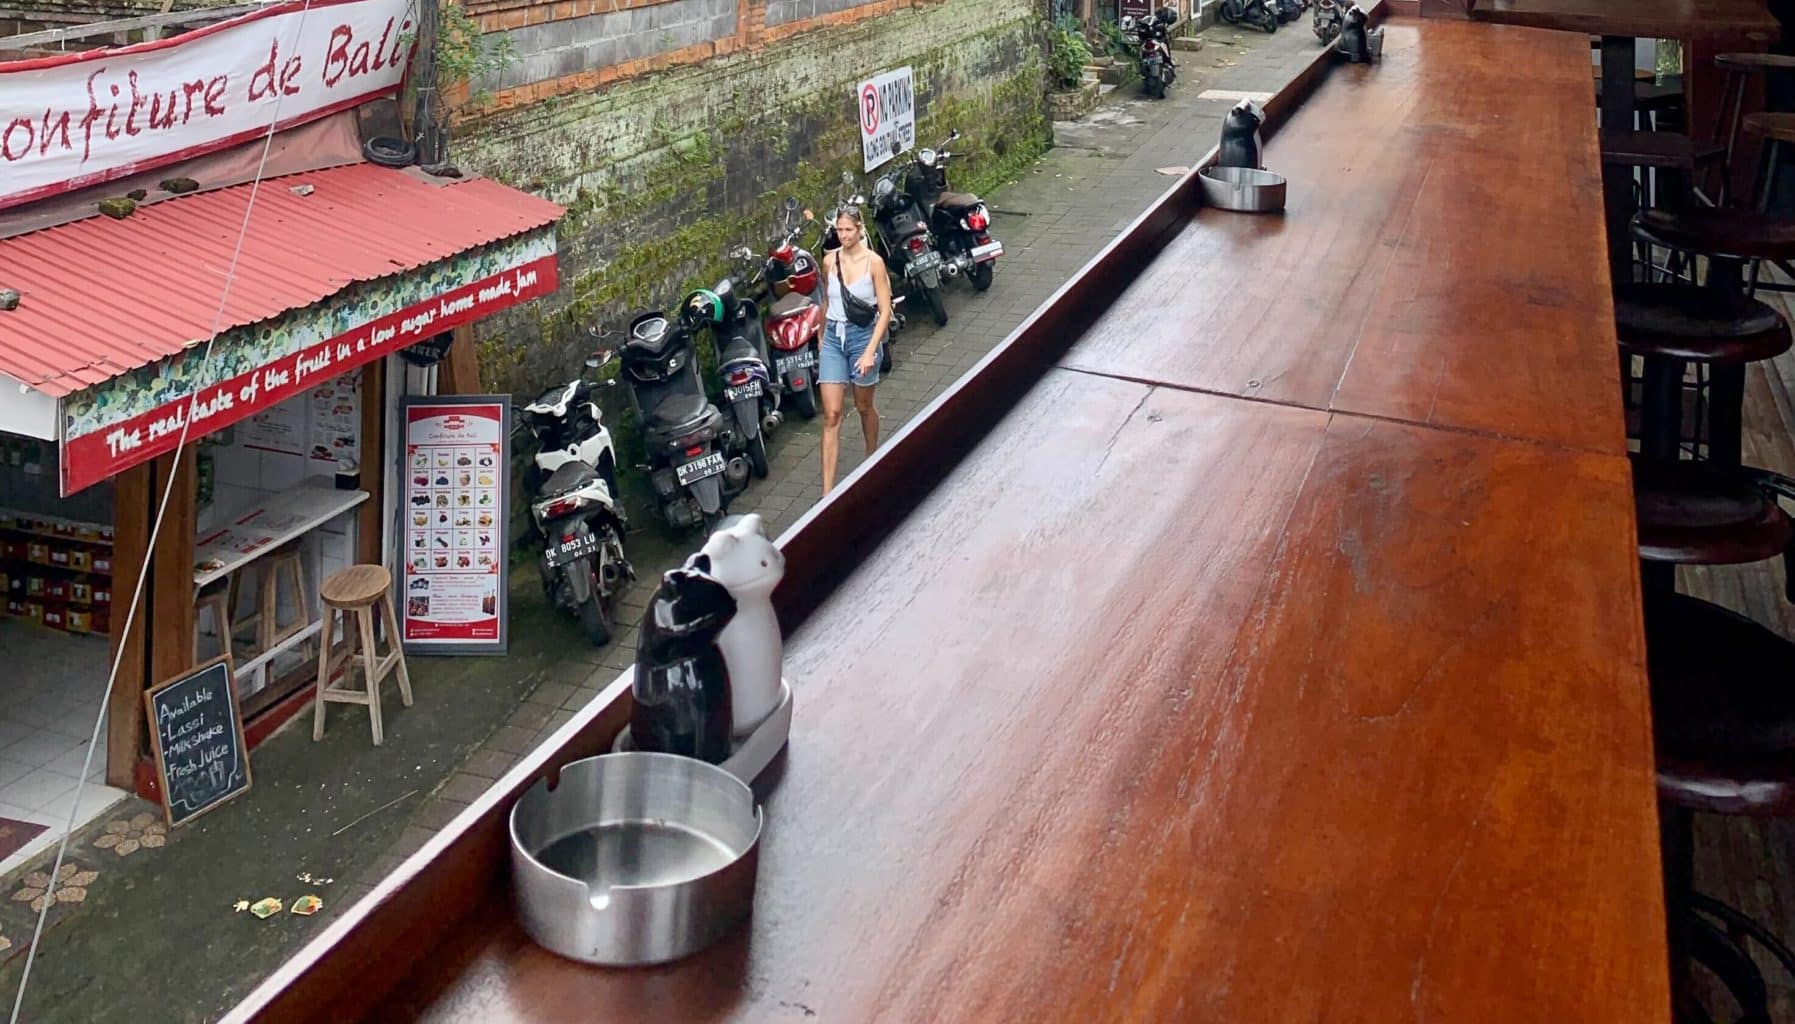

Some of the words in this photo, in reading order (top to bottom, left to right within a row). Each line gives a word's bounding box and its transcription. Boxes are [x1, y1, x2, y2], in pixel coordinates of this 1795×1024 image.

[0, 66, 228, 164] onfiture
[249, 36, 301, 102] de
[322, 16, 412, 89] Bali
[879, 83, 889, 125] NO
[888, 74, 912, 120] PARKING
[106, 427, 142, 457] The
[149, 405, 185, 442] real
[191, 388, 234, 423] taste
[239, 370, 260, 405] of
[264, 368, 289, 392] the
[294, 349, 331, 385] fruit
[337, 342, 351, 362] in
[356, 337, 365, 352] a
[371, 325, 395, 346] low
[400, 306, 437, 336] sugar
[440, 298, 475, 319] home
[478, 278, 511, 303] made
[545, 547, 557, 559] DK
[561, 538, 581, 553] 8053
[583, 532, 596, 545] LU
[159, 687, 213, 725] Available
[199, 743, 229, 768] Juice
